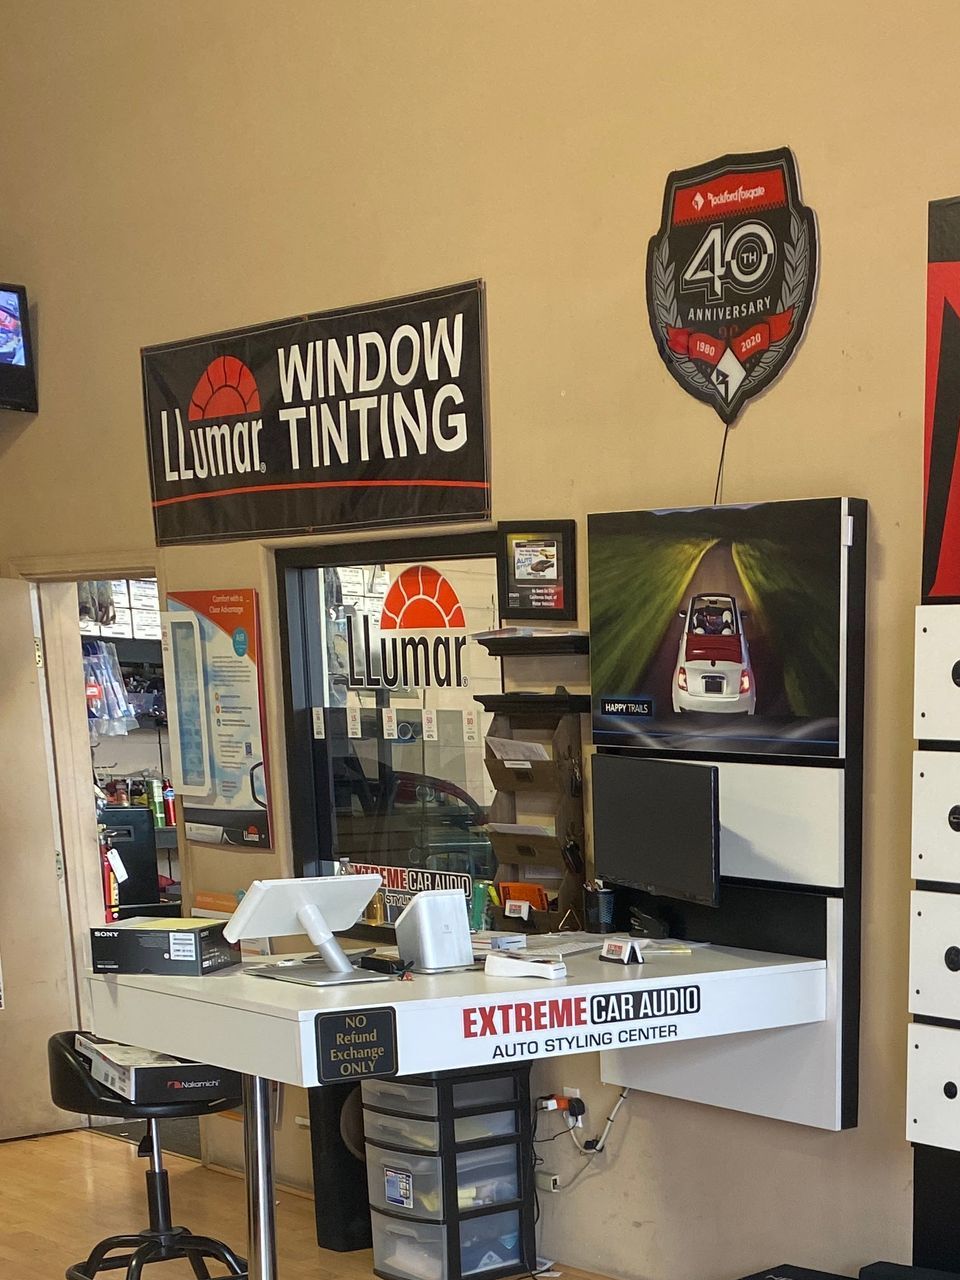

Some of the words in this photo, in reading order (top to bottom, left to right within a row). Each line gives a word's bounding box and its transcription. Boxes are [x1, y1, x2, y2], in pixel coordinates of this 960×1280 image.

[707, 189, 738, 206] Rockford
[688, 296, 771, 320] ANNIVERSARY
[697, 341, 715, 356] 1980
[741, 333, 761, 352] 2020
[277, 313, 464, 404] WINDOW
[278, 384, 468, 470] TINTING
[346, 615, 466, 688] LLumar
[605, 703, 626, 713] HAPPY
[628, 704, 649, 713] TRAILS
[409, 871, 432, 891] CAR
[462, 997, 588, 1038] EXTREME
[591, 995, 634, 1022] CAR
[639, 986, 699, 1018] AUDIO
[345, 1015, 367, 1029] NO
[336, 1029, 377, 1043] Refund
[492, 1041, 538, 1059] AUTO
[545, 1031, 612, 1053] STYLING
[618, 1024, 678, 1044] CENTER
[330, 1044, 385, 1062] Exchange
[340, 1060, 376, 1076] ONLY
[181, 1079, 220, 1088] Nakamichi
